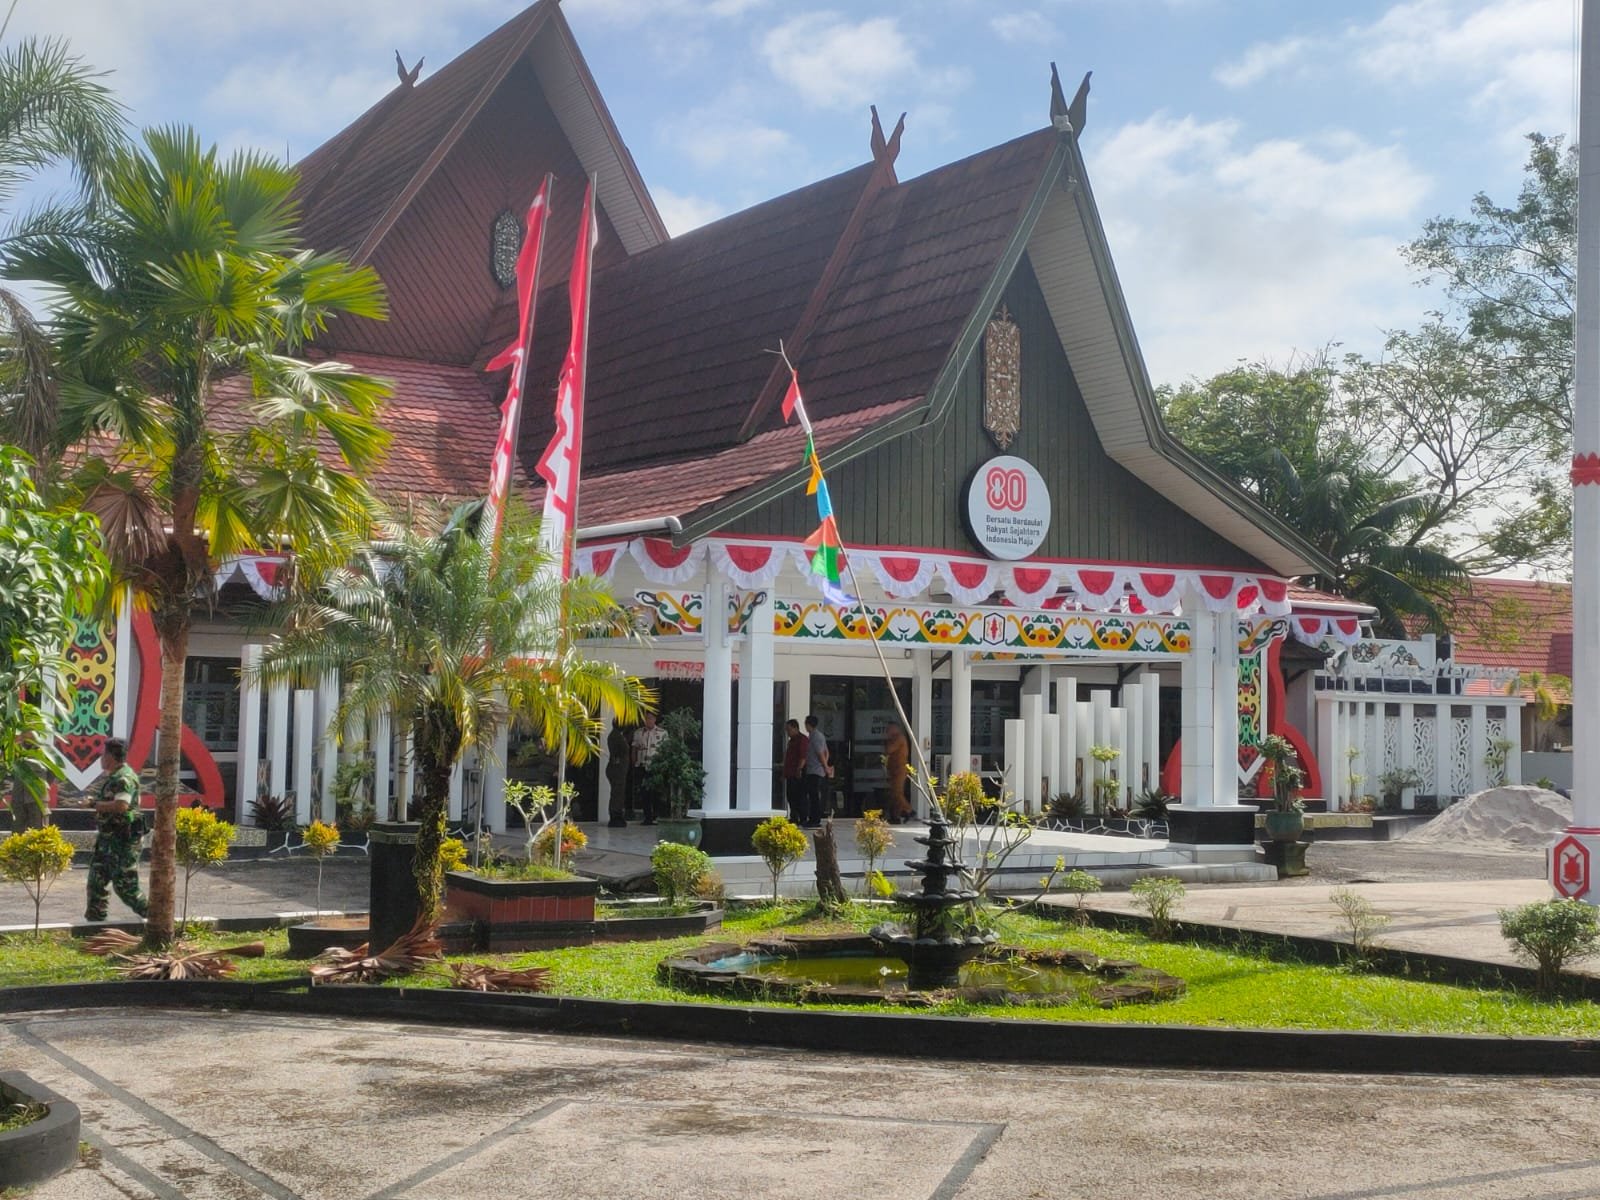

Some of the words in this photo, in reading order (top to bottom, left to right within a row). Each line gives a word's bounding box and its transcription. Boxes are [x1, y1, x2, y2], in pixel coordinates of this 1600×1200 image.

[986, 466, 1027, 512] 80
[986, 515, 1011, 525] Bersatu
[1012, 517, 1043, 527] Berdaulat
[986, 525, 1008, 535] Rakyat
[1009, 527, 1040, 537] Sejahtera
[986, 535, 1017, 545] Indonesia
